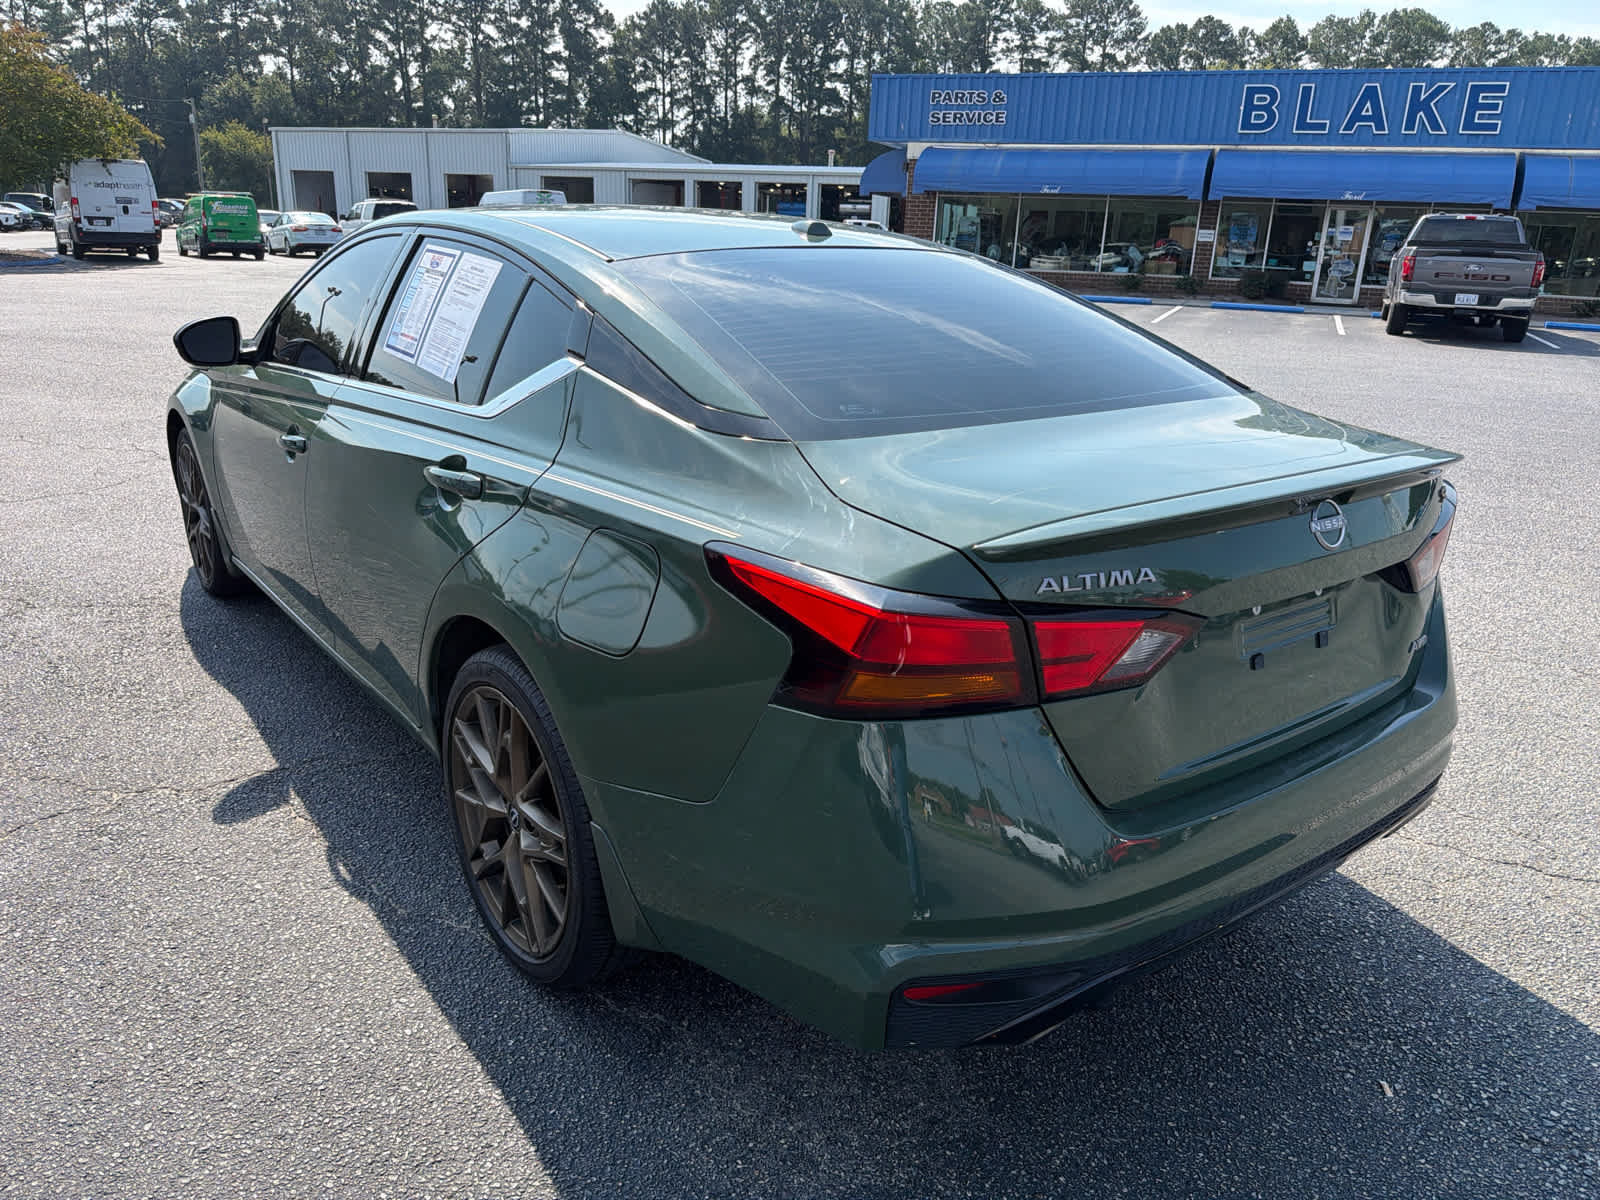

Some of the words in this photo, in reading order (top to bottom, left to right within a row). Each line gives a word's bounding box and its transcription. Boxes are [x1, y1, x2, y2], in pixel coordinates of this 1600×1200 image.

[930, 90, 988, 104] PARTS
[991, 90, 1006, 104] &
[1238, 82, 1510, 134] BLAKE
[929, 110, 1006, 125] SERVICE
[1340, 191, 1367, 200] Ford
[1434, 272, 1511, 281] F-150
[1311, 517, 1345, 531] NISSA
[1037, 567, 1157, 594] ALTIMA
